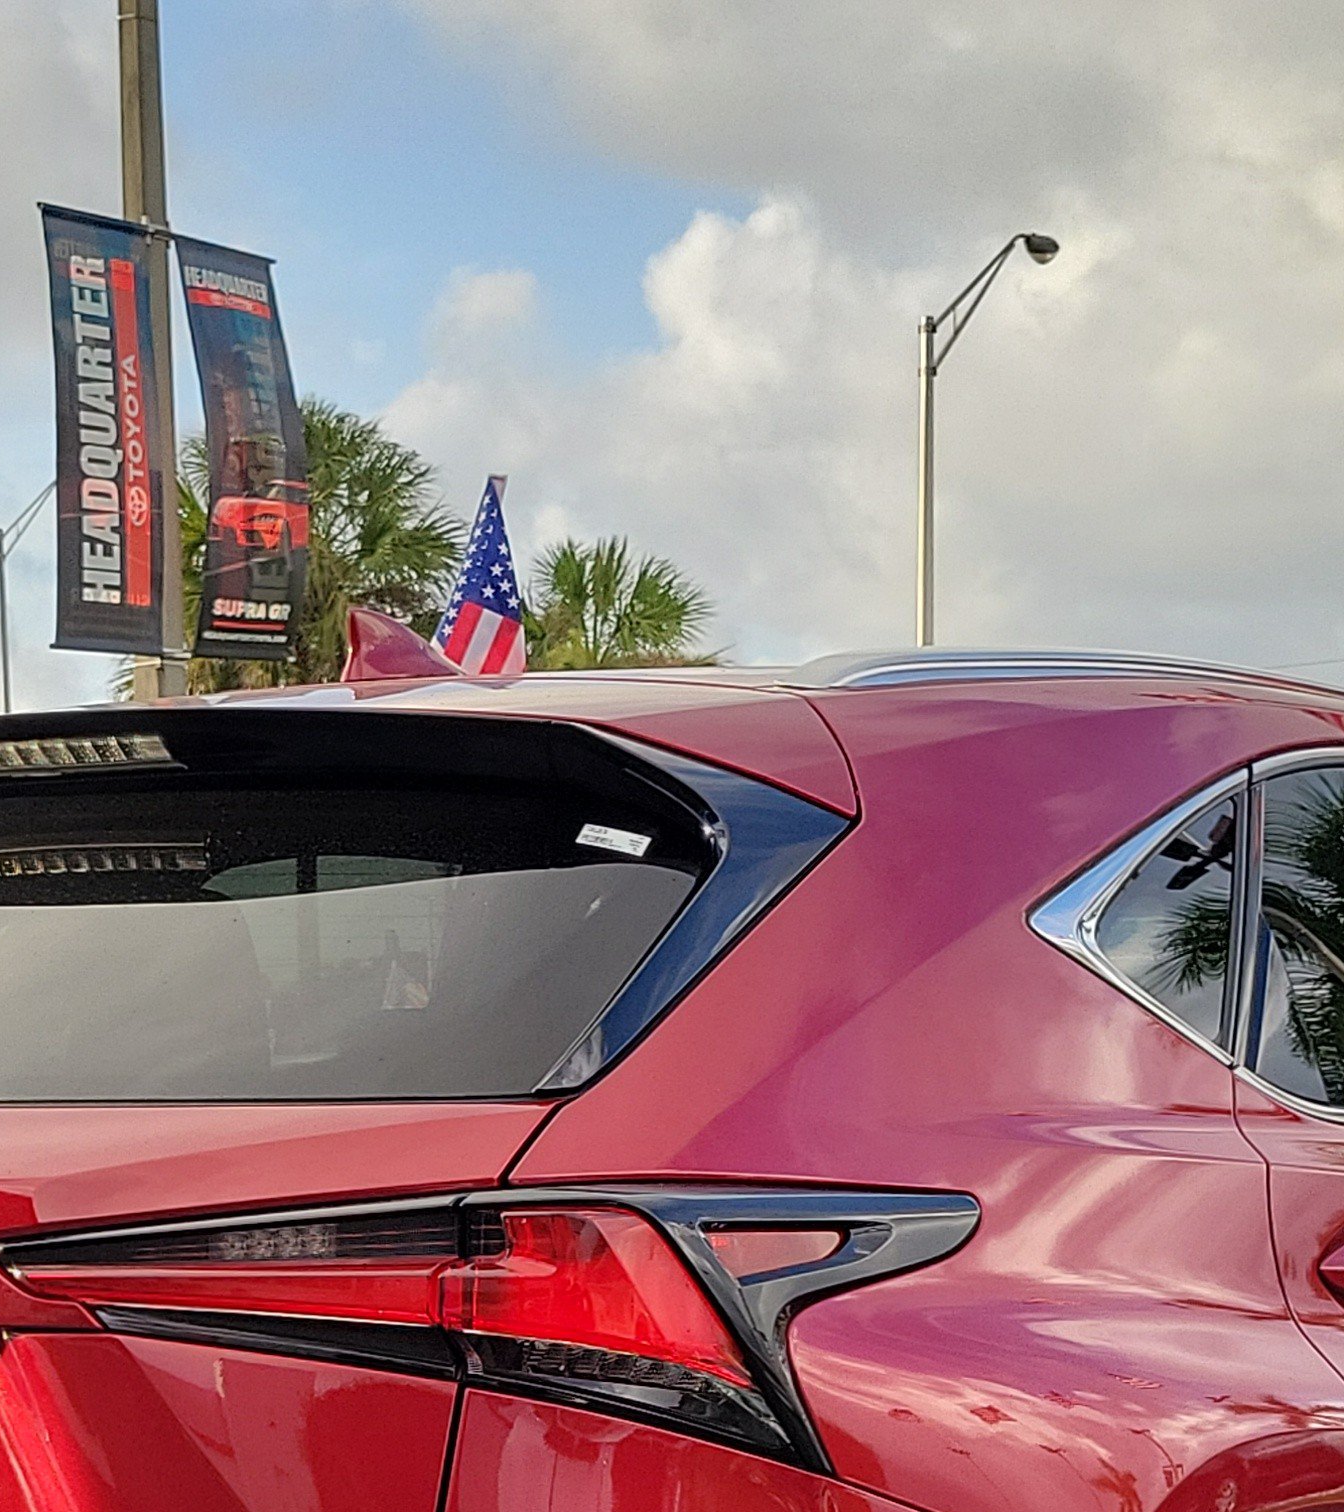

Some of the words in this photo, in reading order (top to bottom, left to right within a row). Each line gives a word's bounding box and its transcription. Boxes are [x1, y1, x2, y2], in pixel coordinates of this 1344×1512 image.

[69, 254, 123, 606] HEADQUARTER
[120, 354, 146, 480] TOYOTA
[212, 597, 267, 620] SUPRA
[268, 602, 292, 621] GR
